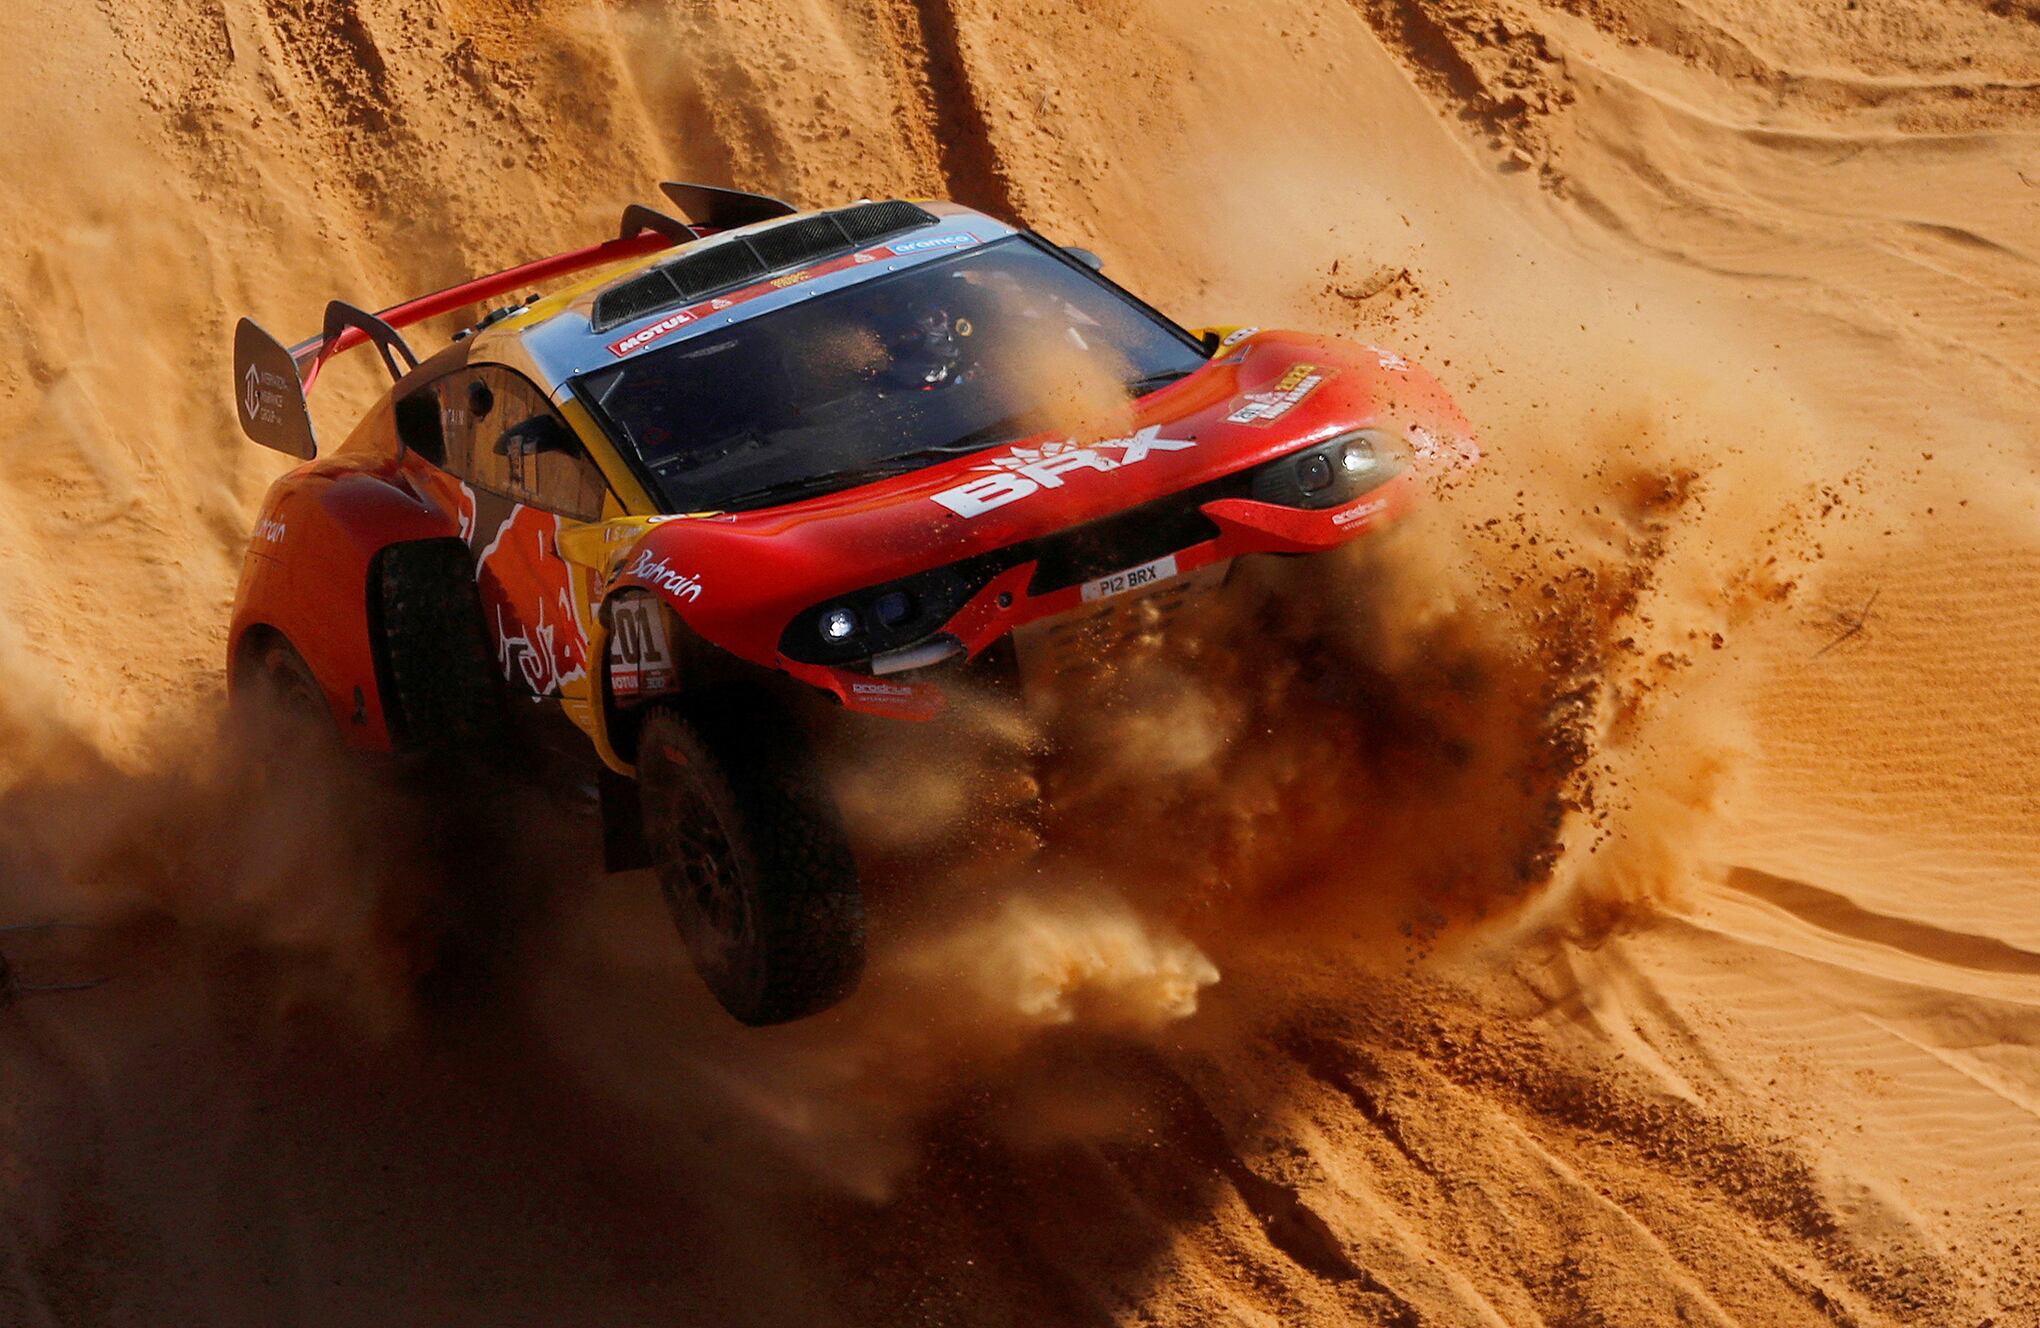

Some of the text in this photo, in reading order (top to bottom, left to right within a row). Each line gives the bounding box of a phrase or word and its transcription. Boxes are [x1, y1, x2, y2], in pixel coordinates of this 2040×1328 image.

[895, 234, 970, 252] aramco
[618, 313, 692, 353] MOTUL
[929, 424, 1199, 519] BRX
[626, 548, 703, 604] Bahrain
[1099, 565, 1157, 596] P12 BRX
